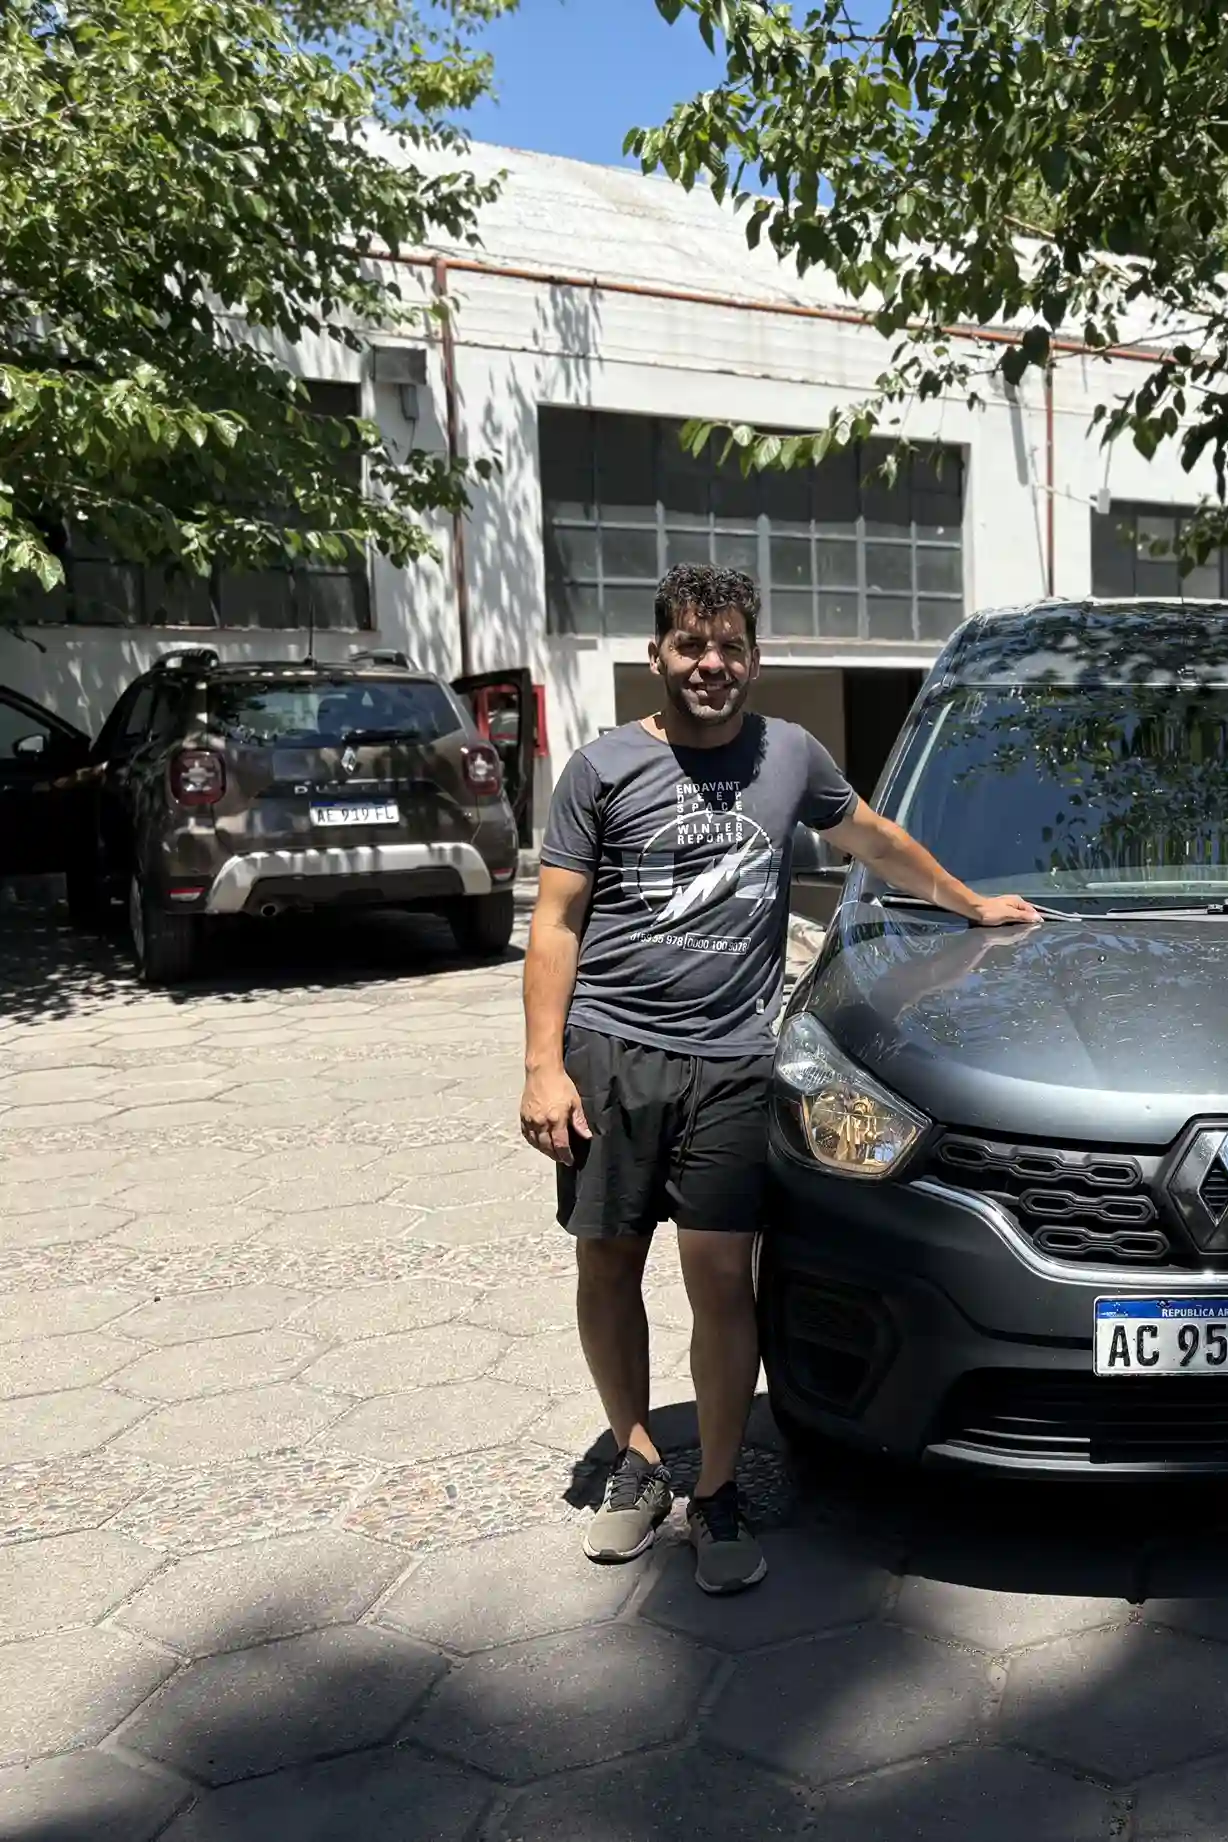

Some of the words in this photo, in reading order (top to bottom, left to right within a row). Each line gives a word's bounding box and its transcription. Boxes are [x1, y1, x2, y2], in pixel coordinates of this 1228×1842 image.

[316, 808, 335, 822] AE
[341, 807, 369, 822] 919
[375, 804, 395, 820] FL
[678, 822, 743, 835] WINTER
[677, 832, 743, 845] REPORTS
[1162, 1308, 1215, 1318] REPUBLICA
[1108, 1324, 1160, 1367] AC
